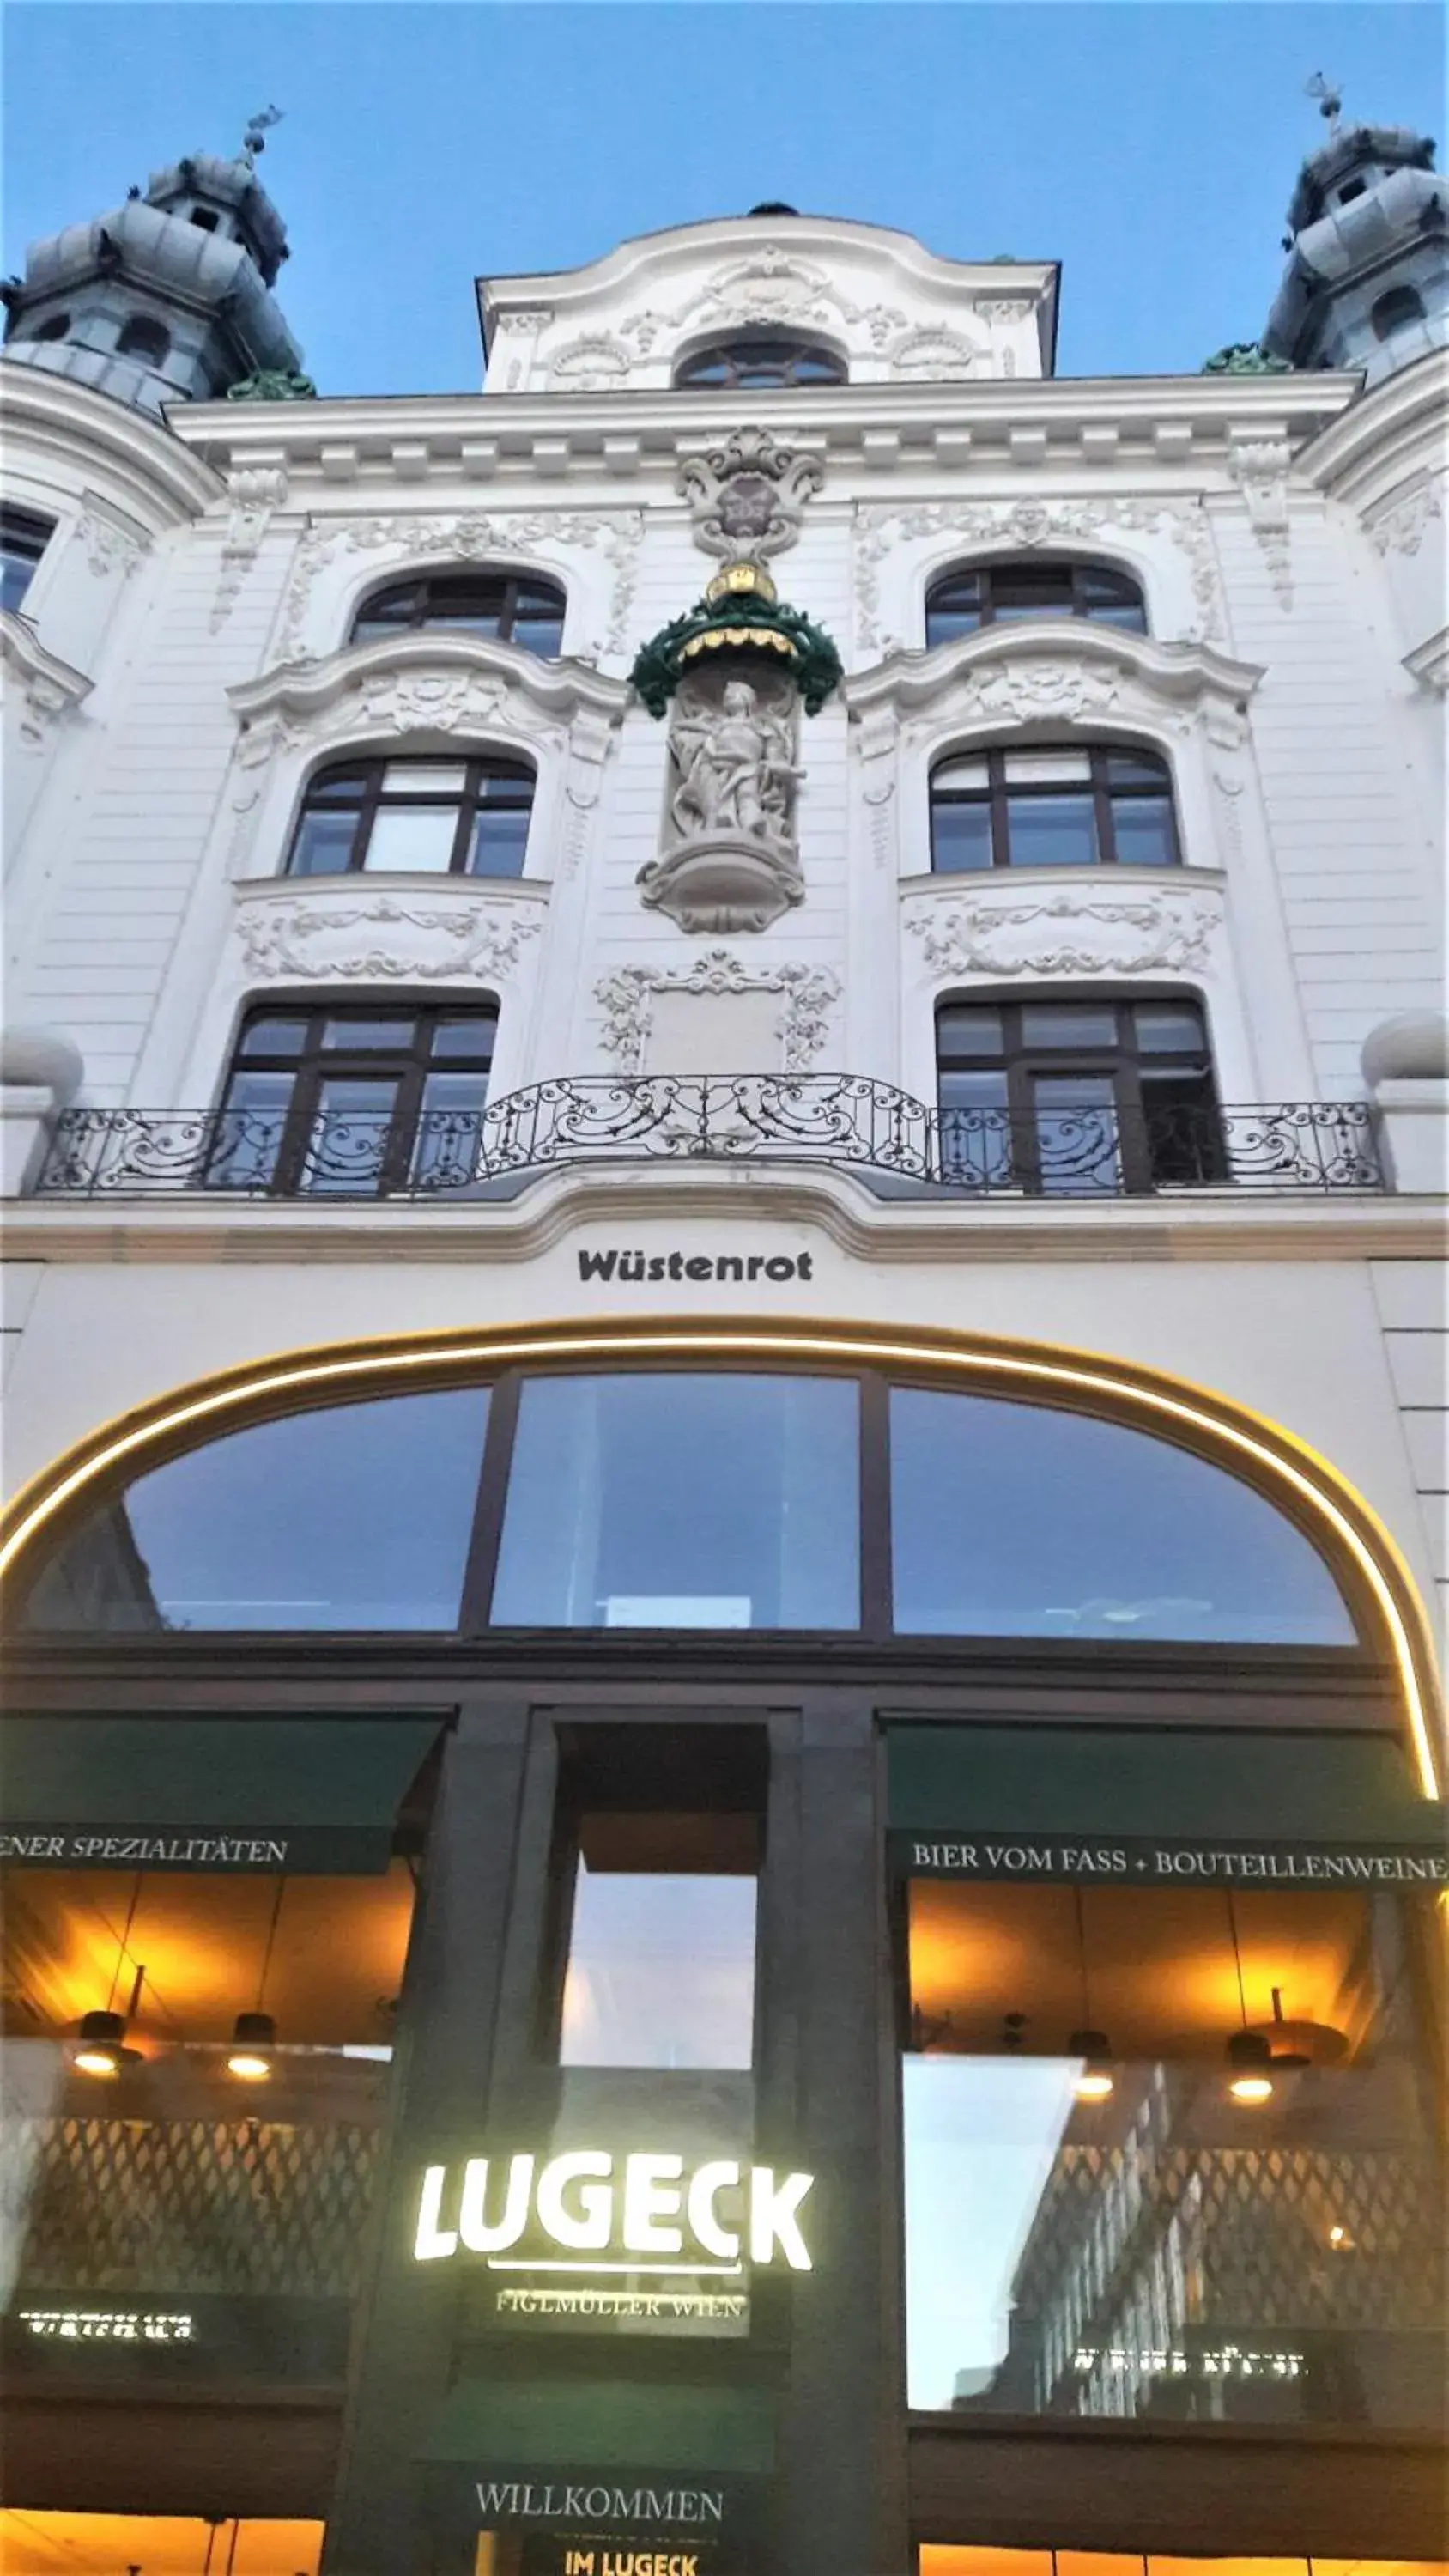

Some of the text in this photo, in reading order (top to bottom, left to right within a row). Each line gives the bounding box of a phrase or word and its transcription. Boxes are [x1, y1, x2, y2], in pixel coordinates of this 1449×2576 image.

[579, 1250, 813, 1281] Wüstenrot
[70, 1835, 288, 1862] SPEZIALITÄTEN
[913, 1844, 1449, 1880] BIER VOM FASS BOUTEILLENWEINE
[414, 2150, 815, 2271] LUGECK
[496, 2288, 748, 2318] FIGLMÜLLER WIEN
[475, 2482, 724, 2522] WILLKOMMEN
[564, 2550, 699, 2576] IM LUGECK
